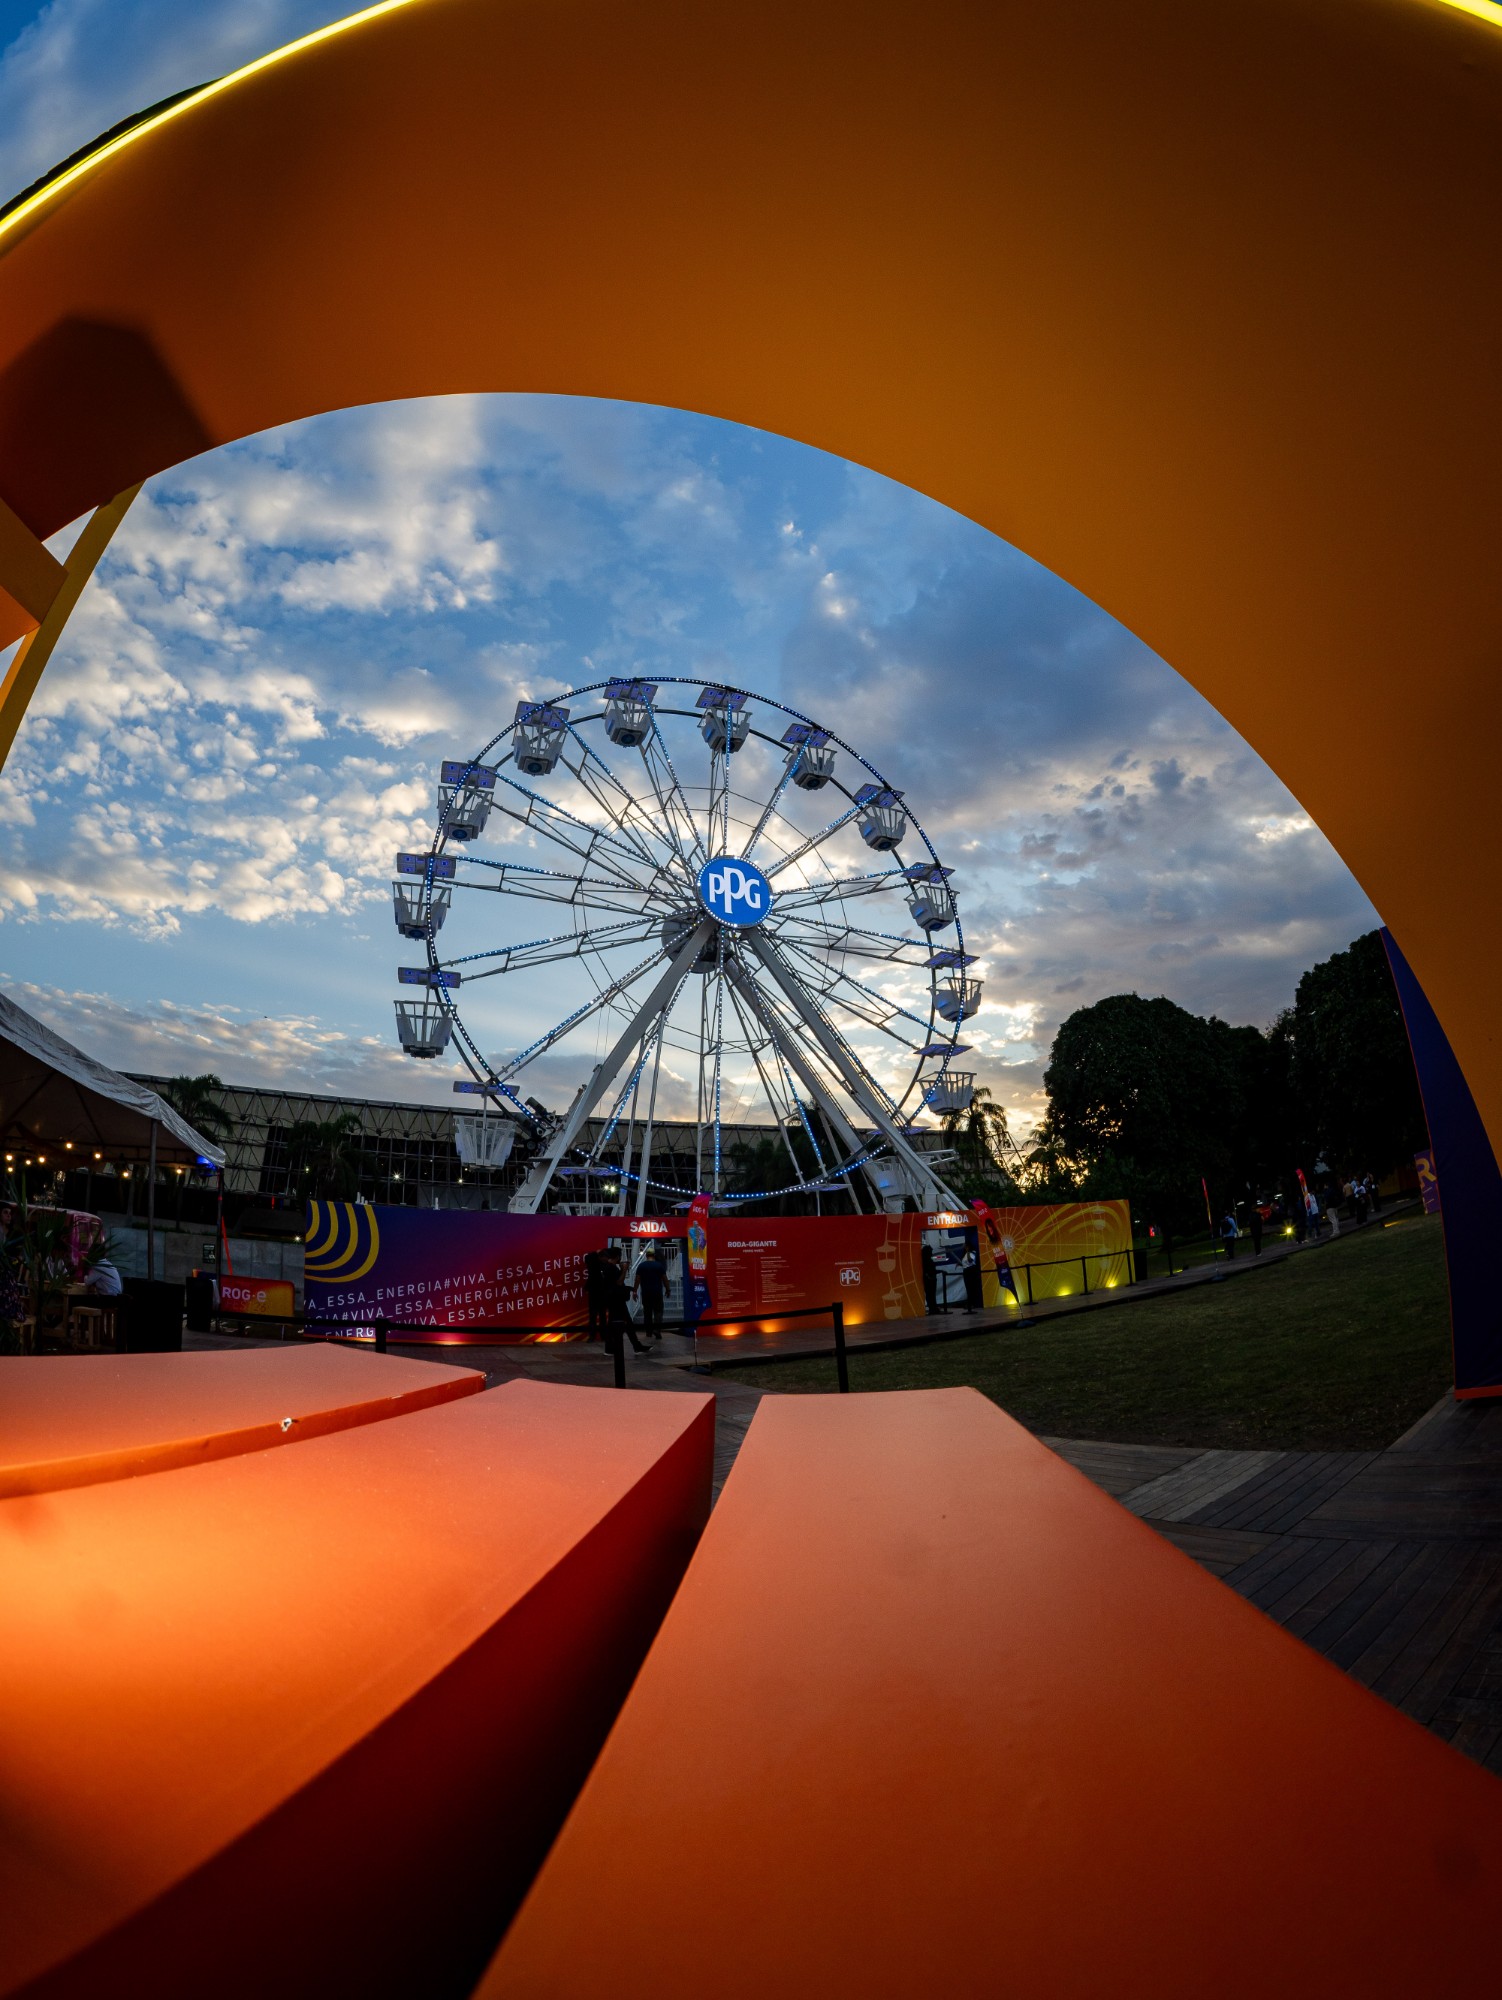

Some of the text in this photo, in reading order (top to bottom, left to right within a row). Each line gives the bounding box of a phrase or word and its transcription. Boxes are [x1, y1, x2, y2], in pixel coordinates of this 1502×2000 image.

[709, 867, 761, 914] PPG
[927, 1214, 968, 1225] ENTRADA
[727, 1240, 777, 1248] RODA-GIGANTE
[841, 1269, 859, 1284] PPG
